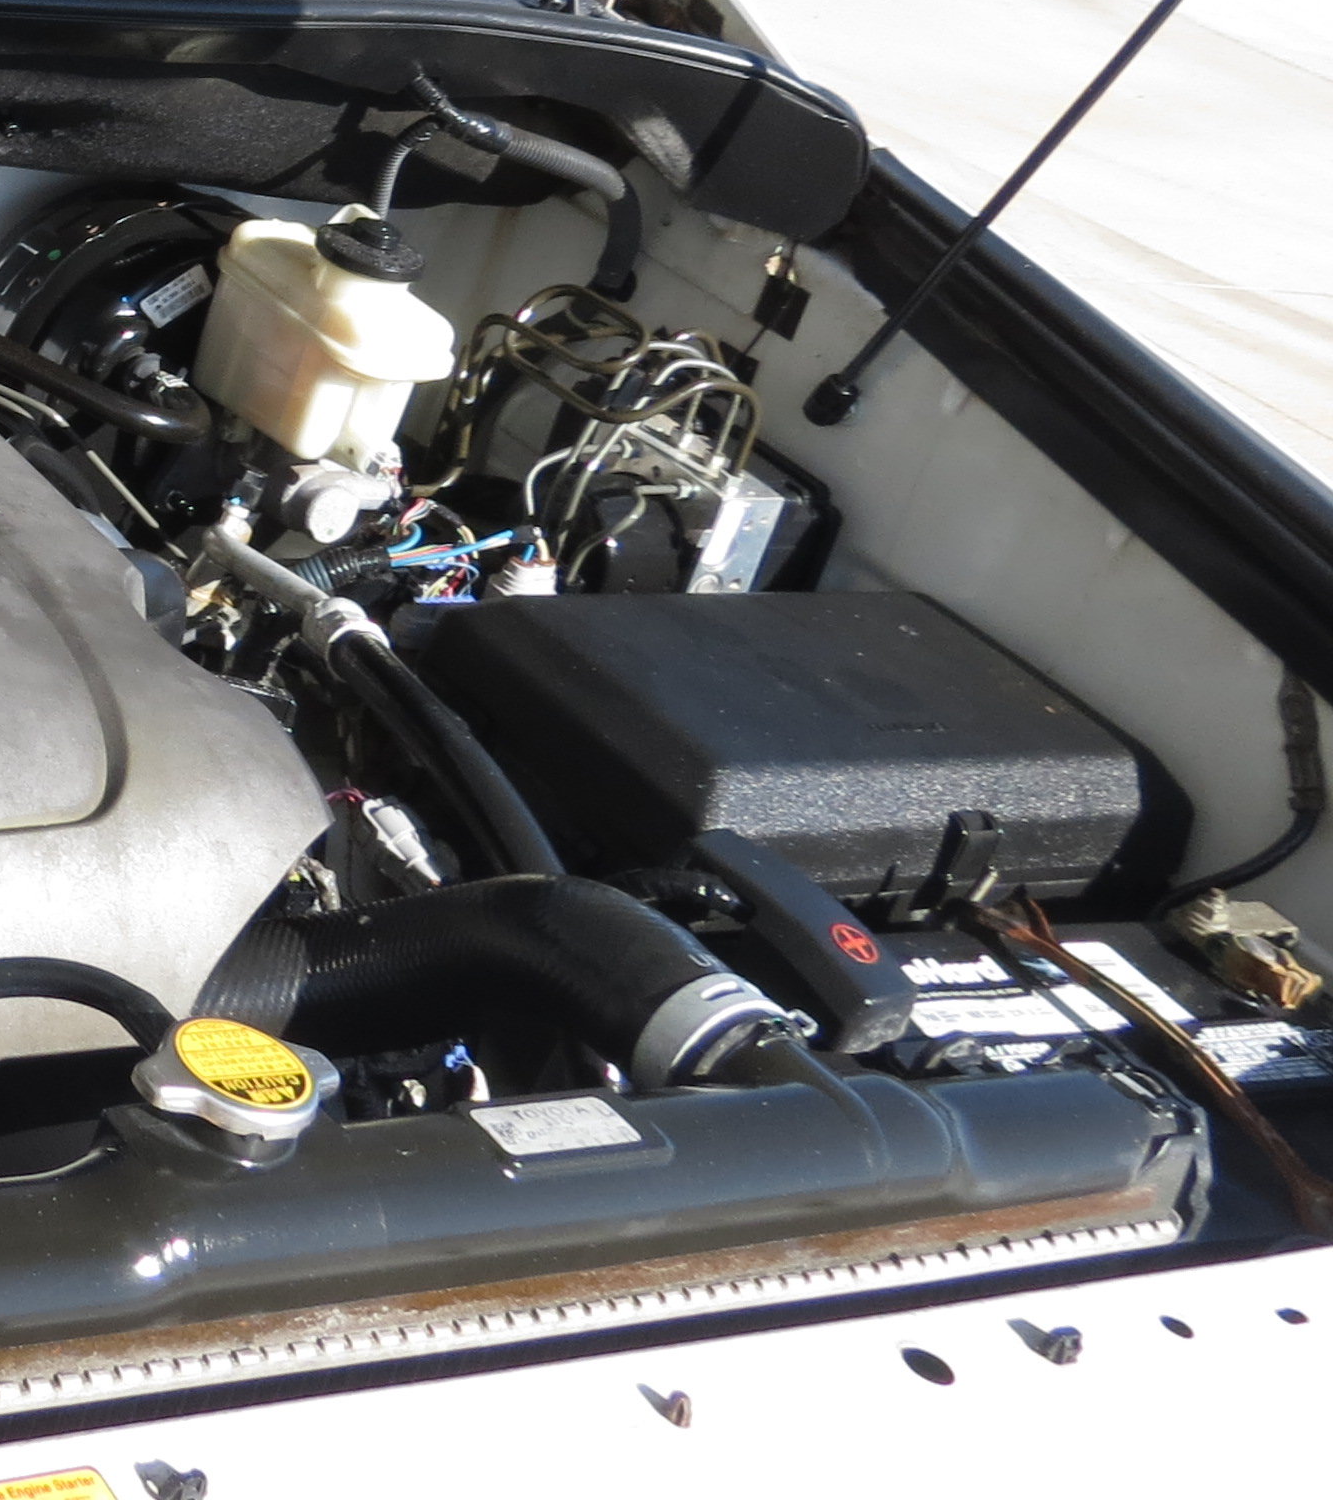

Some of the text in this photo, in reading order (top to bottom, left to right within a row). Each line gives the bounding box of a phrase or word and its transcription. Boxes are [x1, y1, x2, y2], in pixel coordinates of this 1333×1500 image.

[221, 1074, 300, 1092] CAUTION
[513, 1104, 588, 1121] TOYOTA
[6, 1482, 52, 1499] Engine
[52, 1476, 95, 1491] Starter
